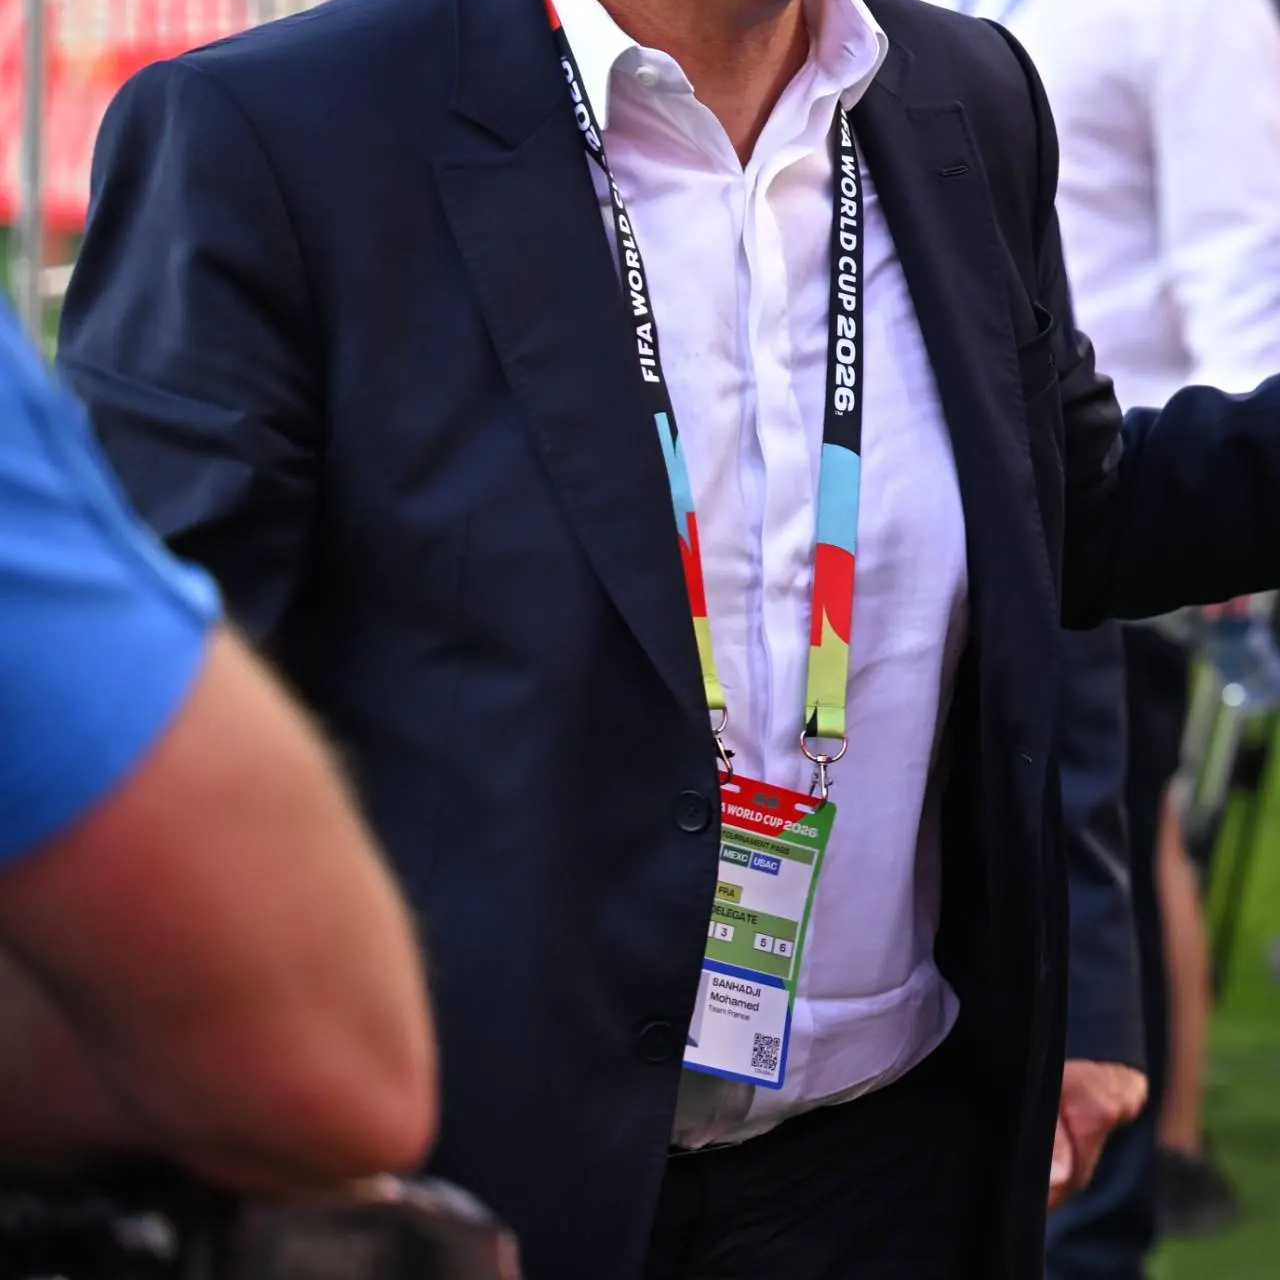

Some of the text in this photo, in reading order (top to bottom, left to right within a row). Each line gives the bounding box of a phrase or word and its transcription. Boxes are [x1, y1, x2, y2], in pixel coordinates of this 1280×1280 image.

[840, 108, 852, 147] IFA
[839, 154, 857, 252] WORLD
[837, 255, 857, 312] CUP
[618, 215, 661, 383] FIFA WORLD
[834, 314, 857, 412] 2026
[727, 803, 762, 823] WORLD
[763, 814, 783, 828] CUP
[783, 820, 818, 838] 2026
[722, 829, 769, 850] TOURNAMENT
[723, 848, 778, 871] MEXC USAC
[718, 886, 735, 898] FRA
[712, 905, 758, 925] DELEGATE
[720, 927, 787, 953] 3 5 6
[712, 977, 761, 998] SANHADJI
[710, 991, 760, 1012] Mohamed
